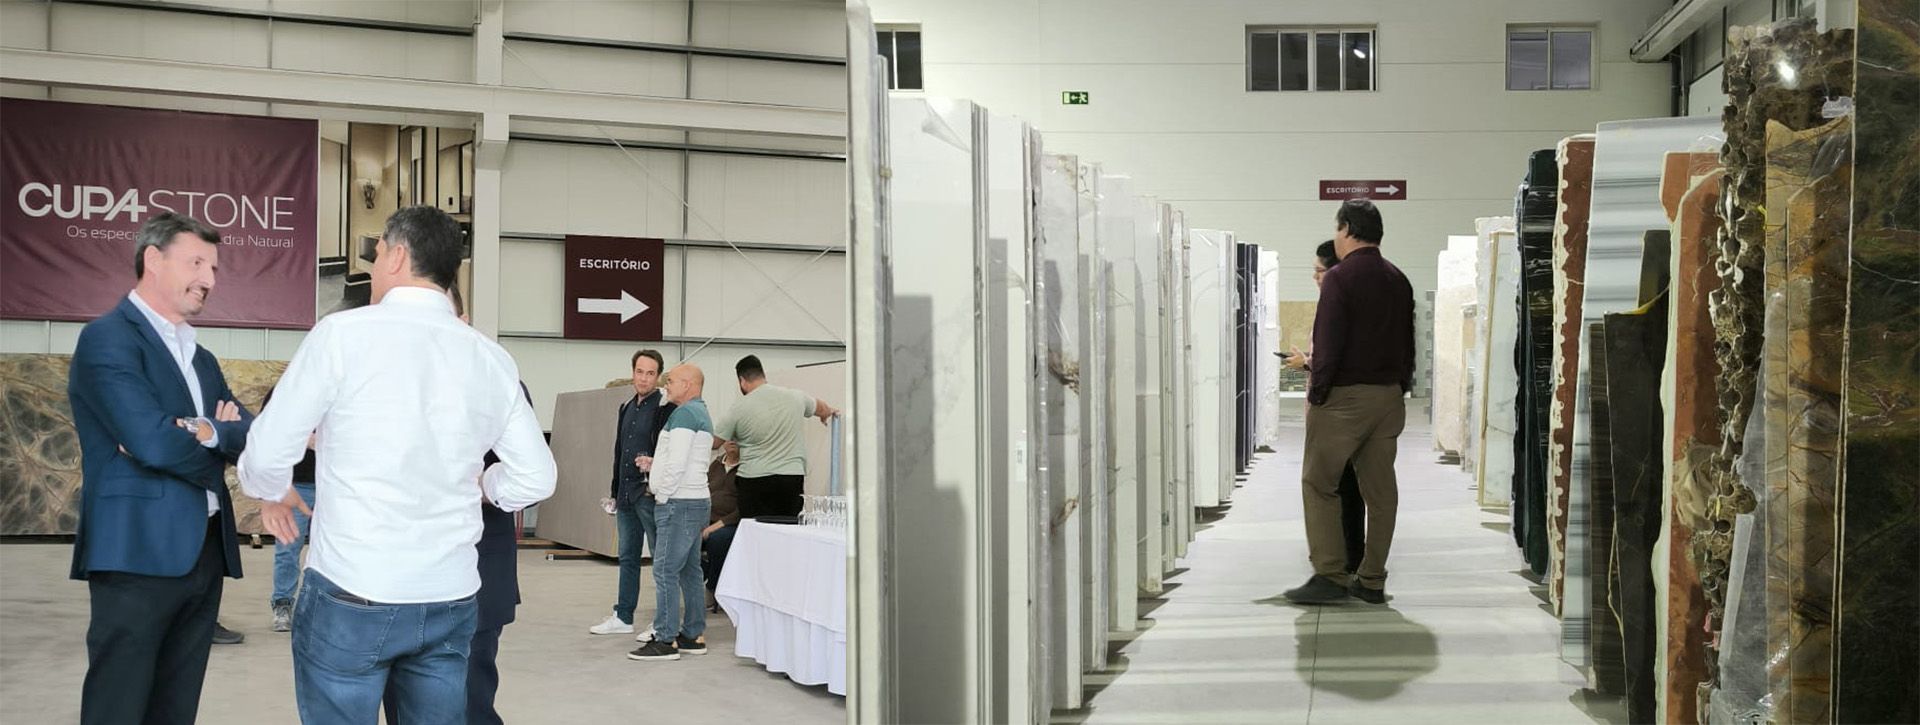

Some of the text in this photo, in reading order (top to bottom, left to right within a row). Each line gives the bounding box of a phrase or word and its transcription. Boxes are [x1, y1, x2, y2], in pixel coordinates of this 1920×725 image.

[66, 225, 87, 238] Os
[91, 229, 141, 241] especia
[247, 234, 293, 248] Natural
[579, 257, 650, 270] ESCRITÓRIO
